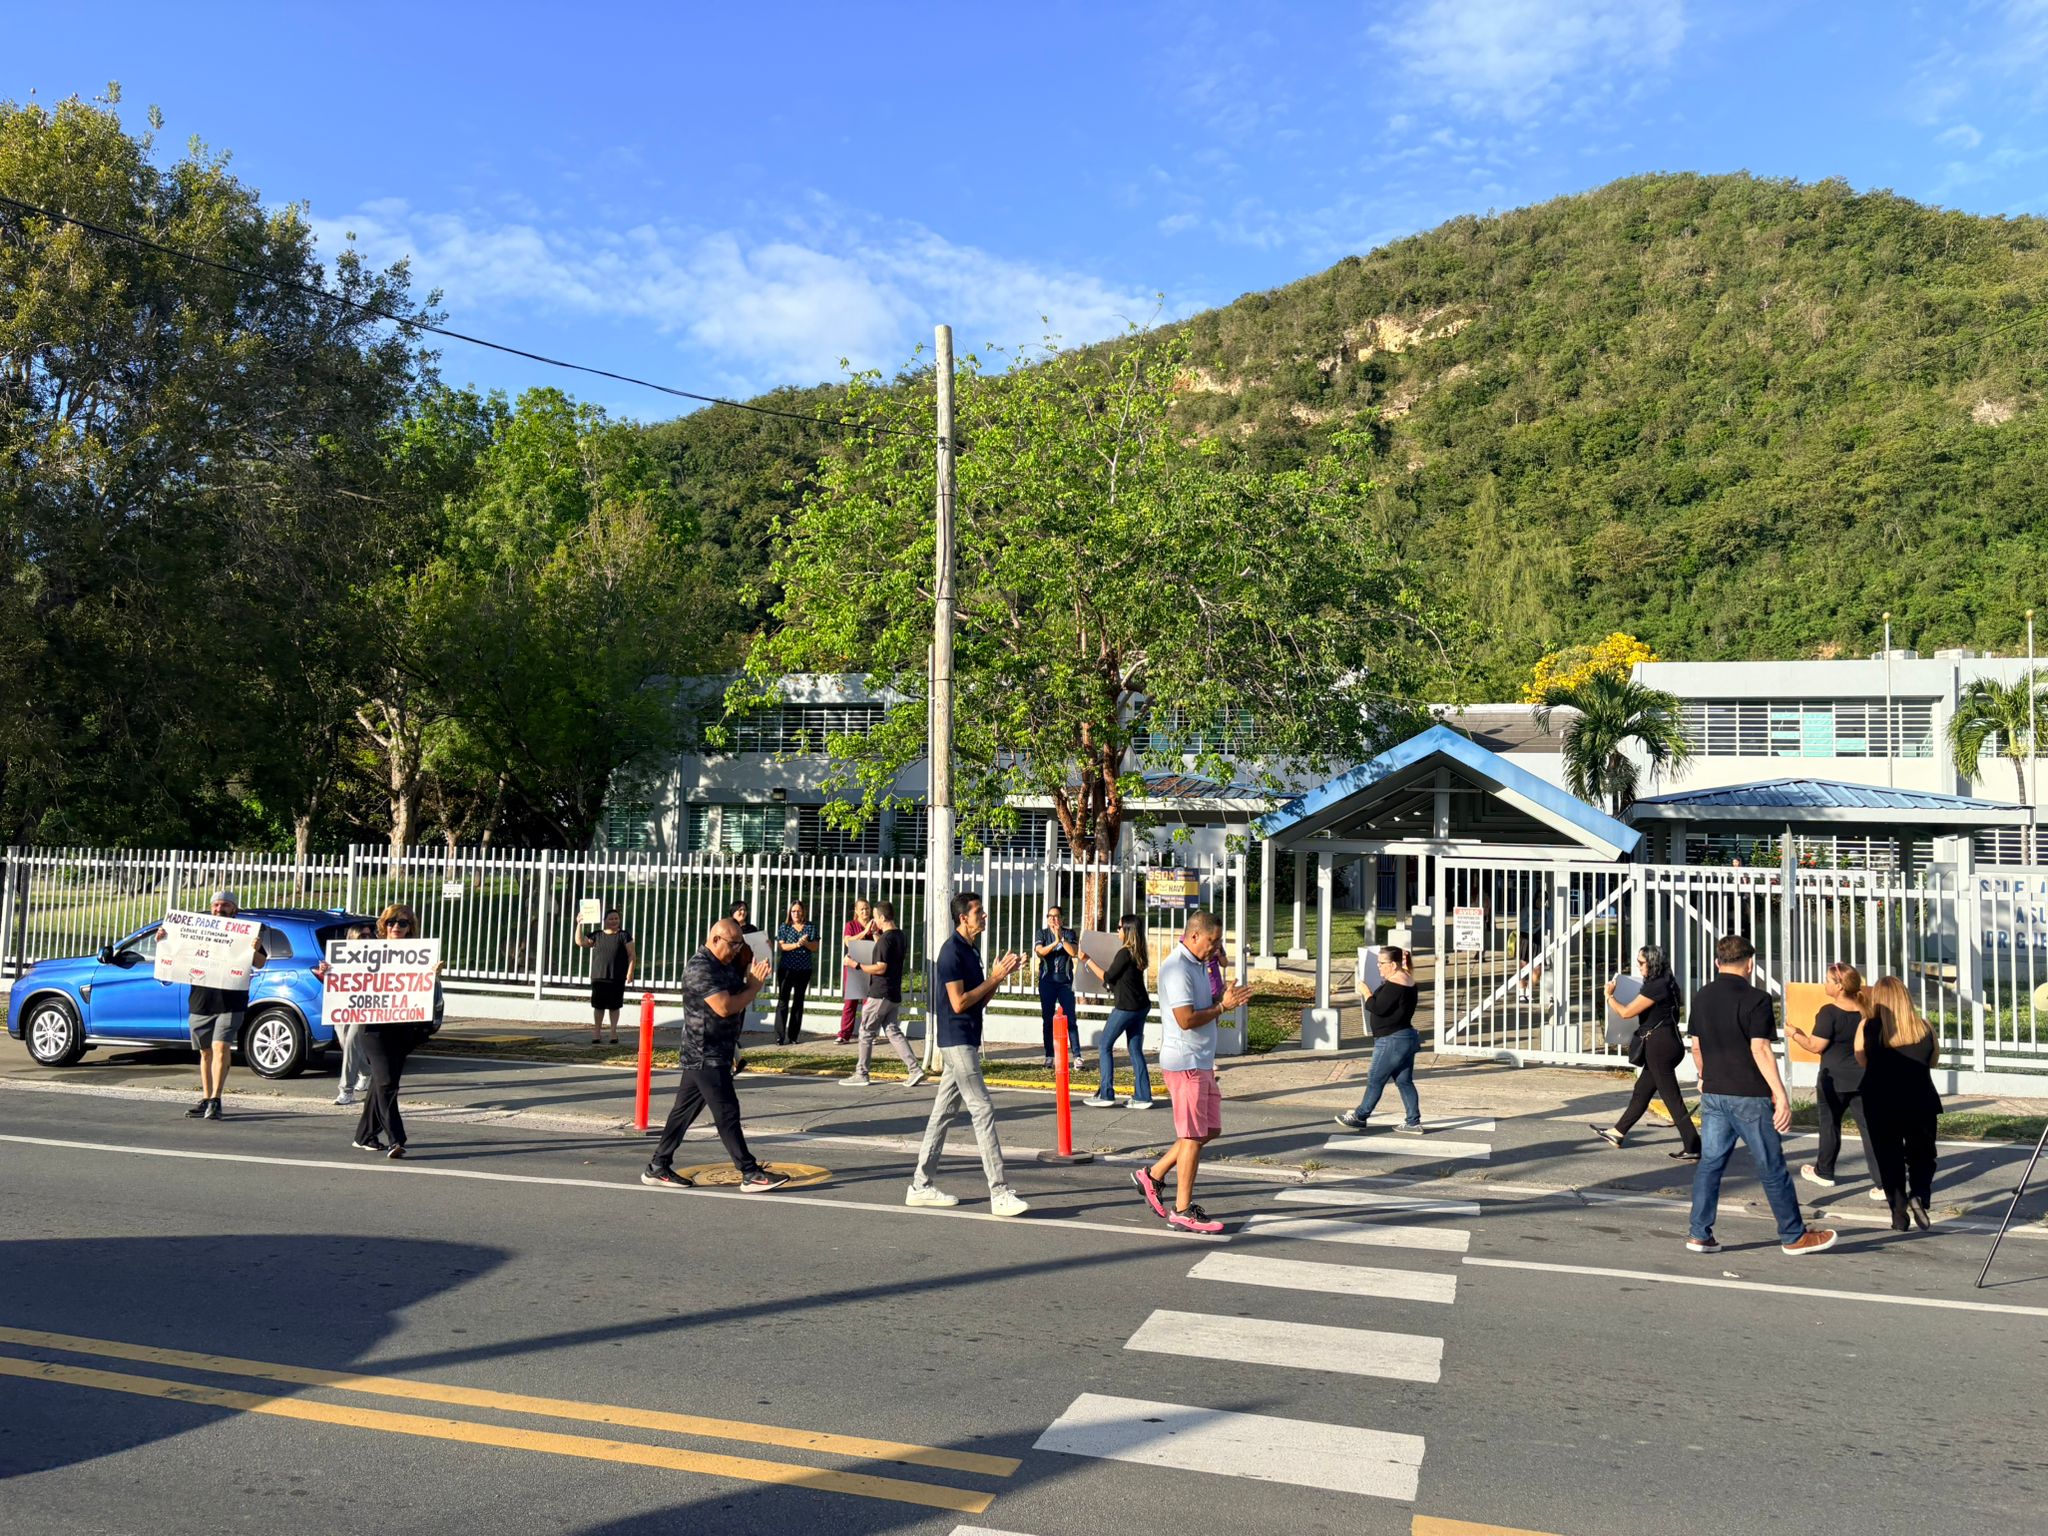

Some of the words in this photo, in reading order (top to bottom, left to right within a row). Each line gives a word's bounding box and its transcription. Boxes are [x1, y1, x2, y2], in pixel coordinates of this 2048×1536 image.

[195, 917, 221, 930] PADRE
[225, 921, 251, 935] EXIGE
[330, 942, 431, 973] Exigimos
[326, 972, 434, 993] RESPUESTAS
[348, 995, 390, 1009] SOBRE
[391, 994, 409, 1009] LA
[330, 1003, 425, 1023] CONSTRUCCIÓN
